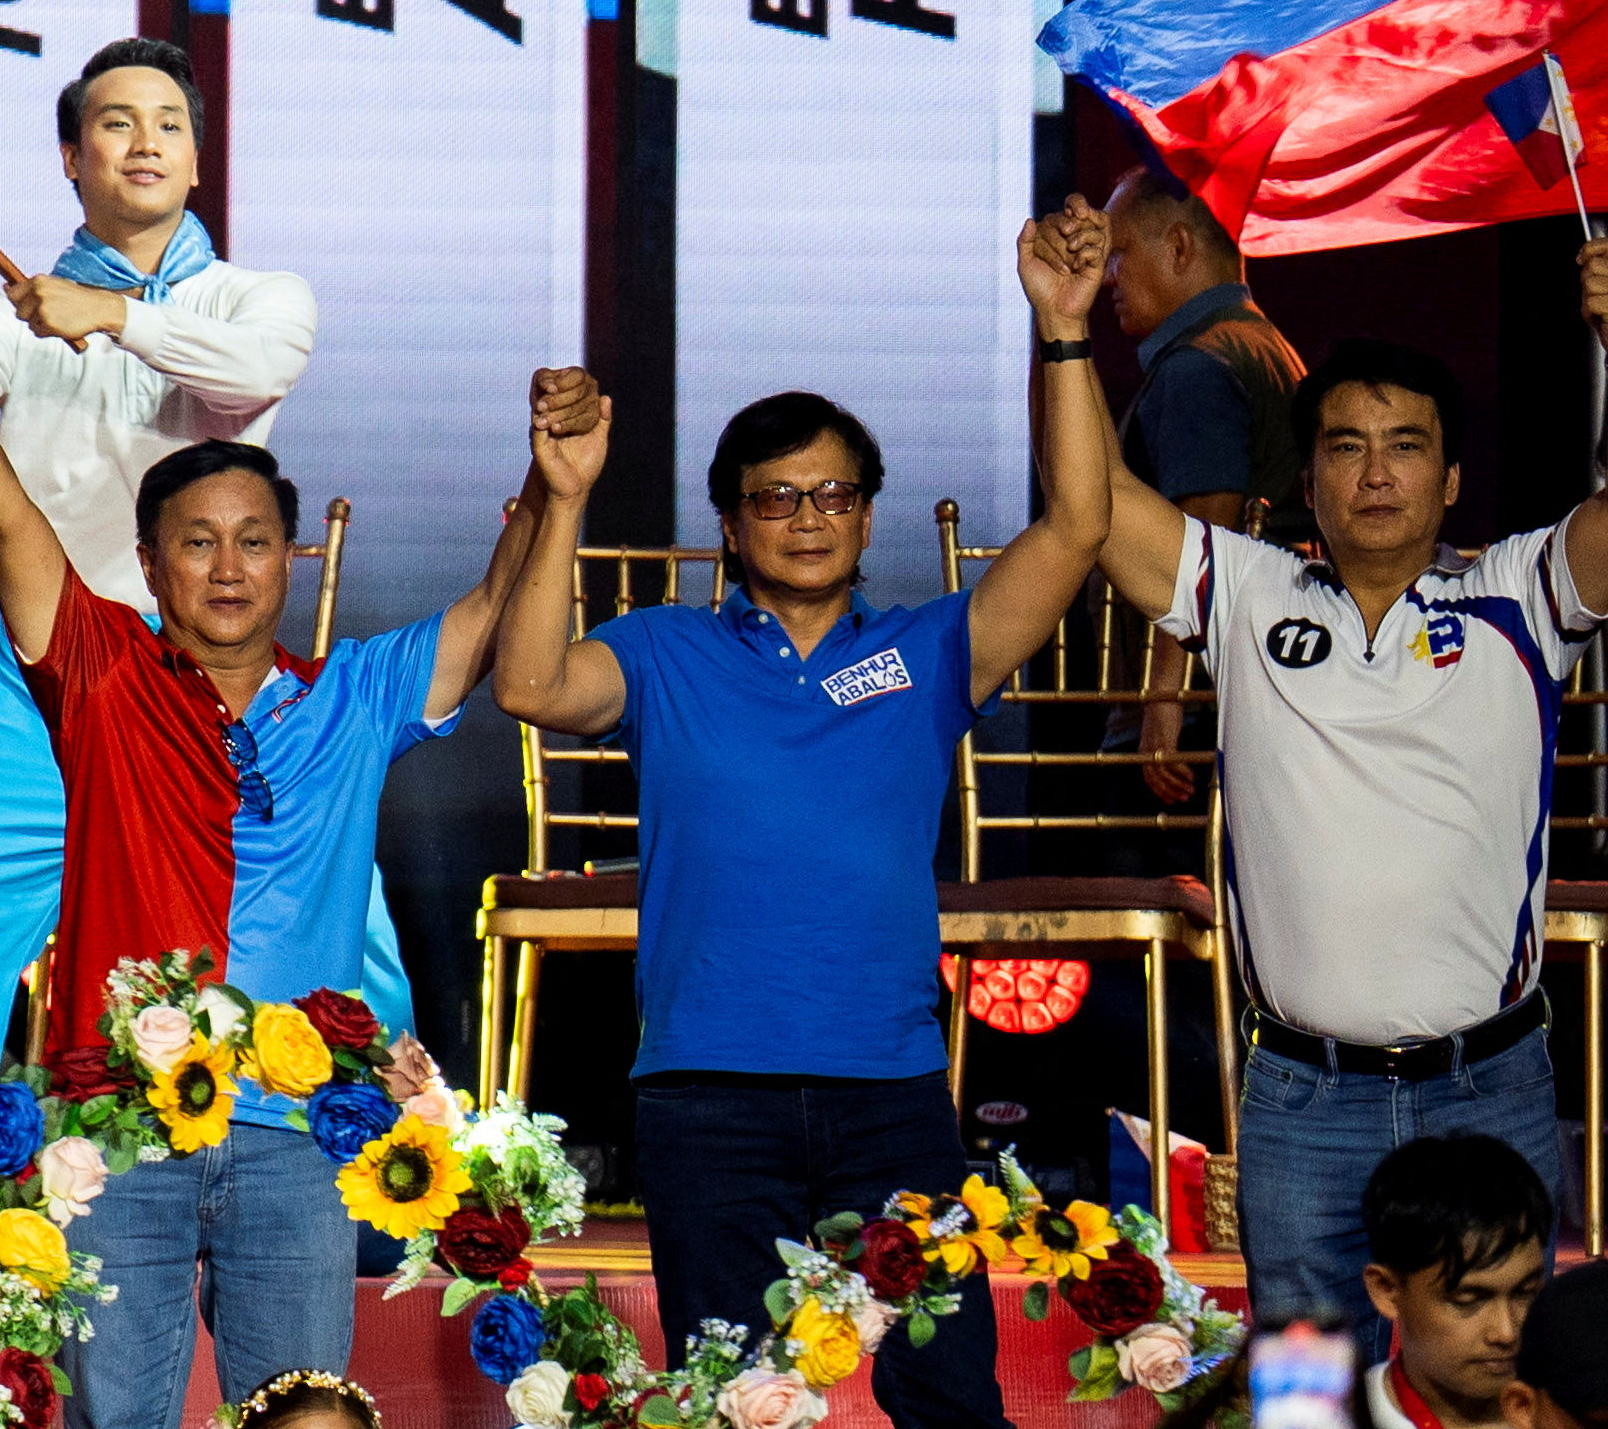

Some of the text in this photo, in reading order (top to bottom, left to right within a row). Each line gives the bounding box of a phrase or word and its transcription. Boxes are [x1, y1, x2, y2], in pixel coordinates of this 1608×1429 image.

[1279, 625, 1320, 661] 11
[825, 652, 901, 694] BENHUR
[838, 668, 909, 706] ABALOS
